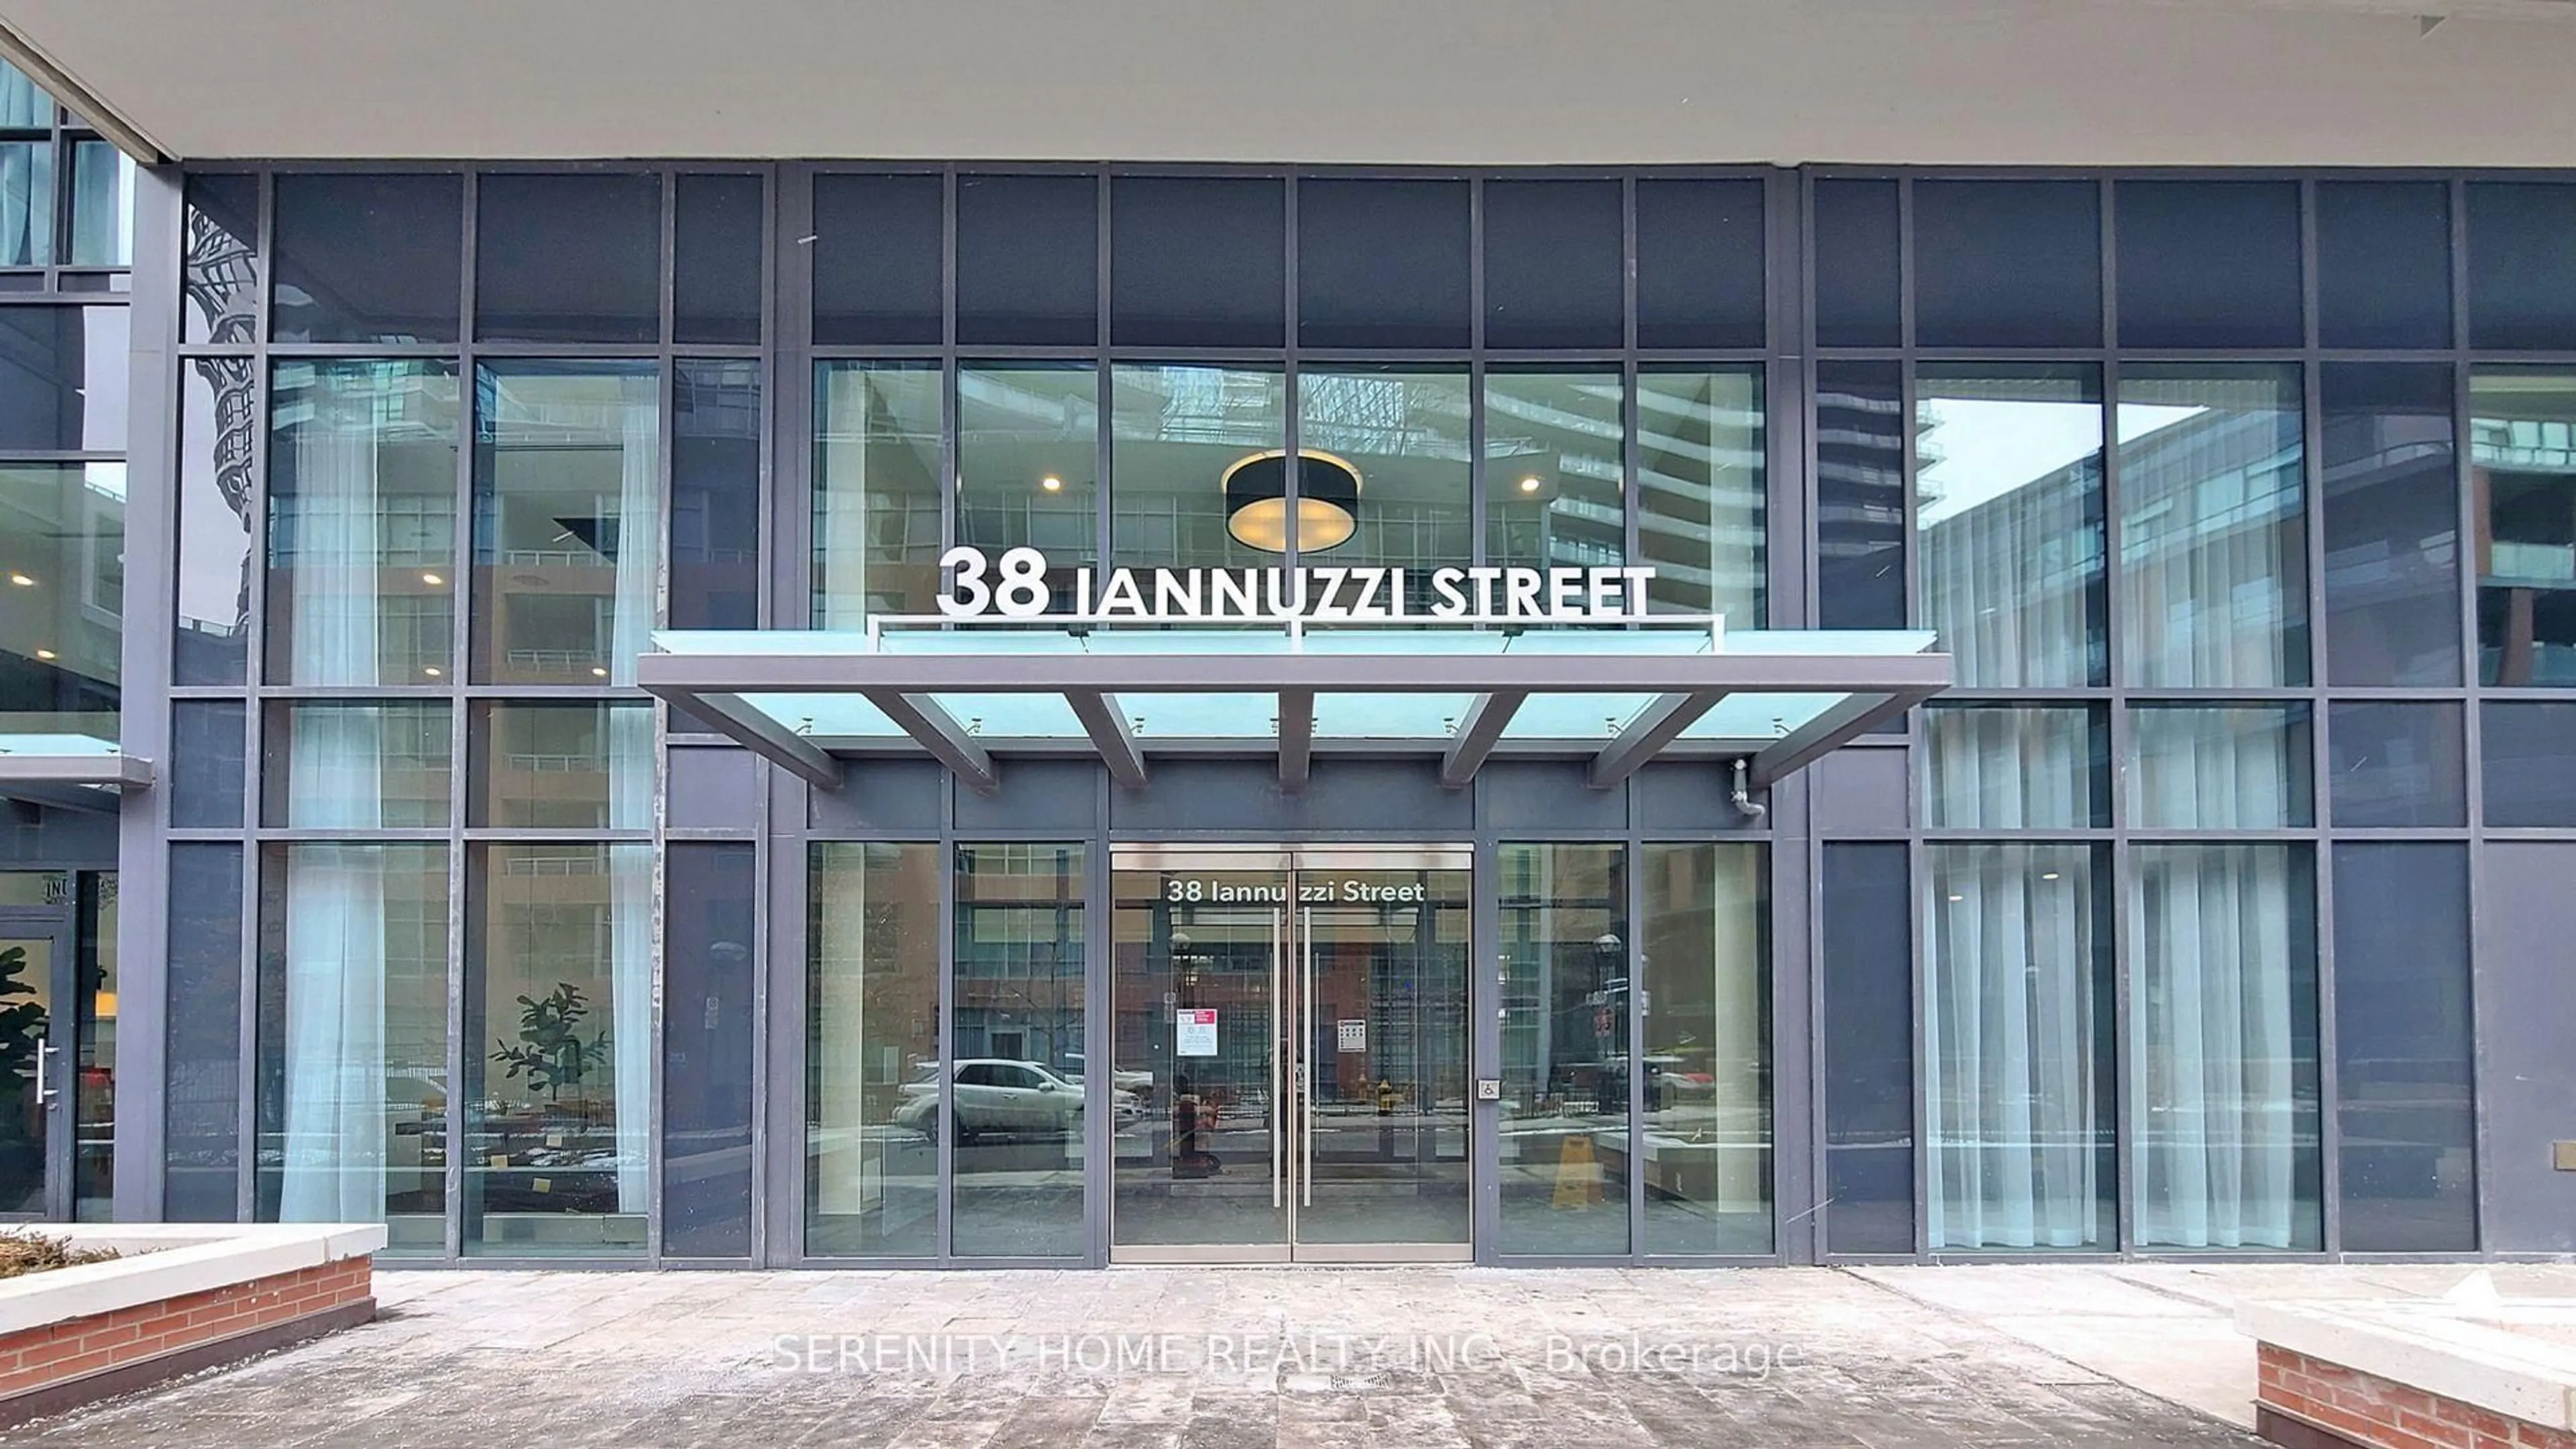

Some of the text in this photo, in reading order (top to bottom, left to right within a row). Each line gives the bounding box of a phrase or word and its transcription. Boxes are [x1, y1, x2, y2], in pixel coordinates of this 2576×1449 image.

[936, 546, 1656, 616] 38 IANNUZZI STREET
[1167, 880, 1203, 902] 38
[1343, 879, 1425, 902] Street
